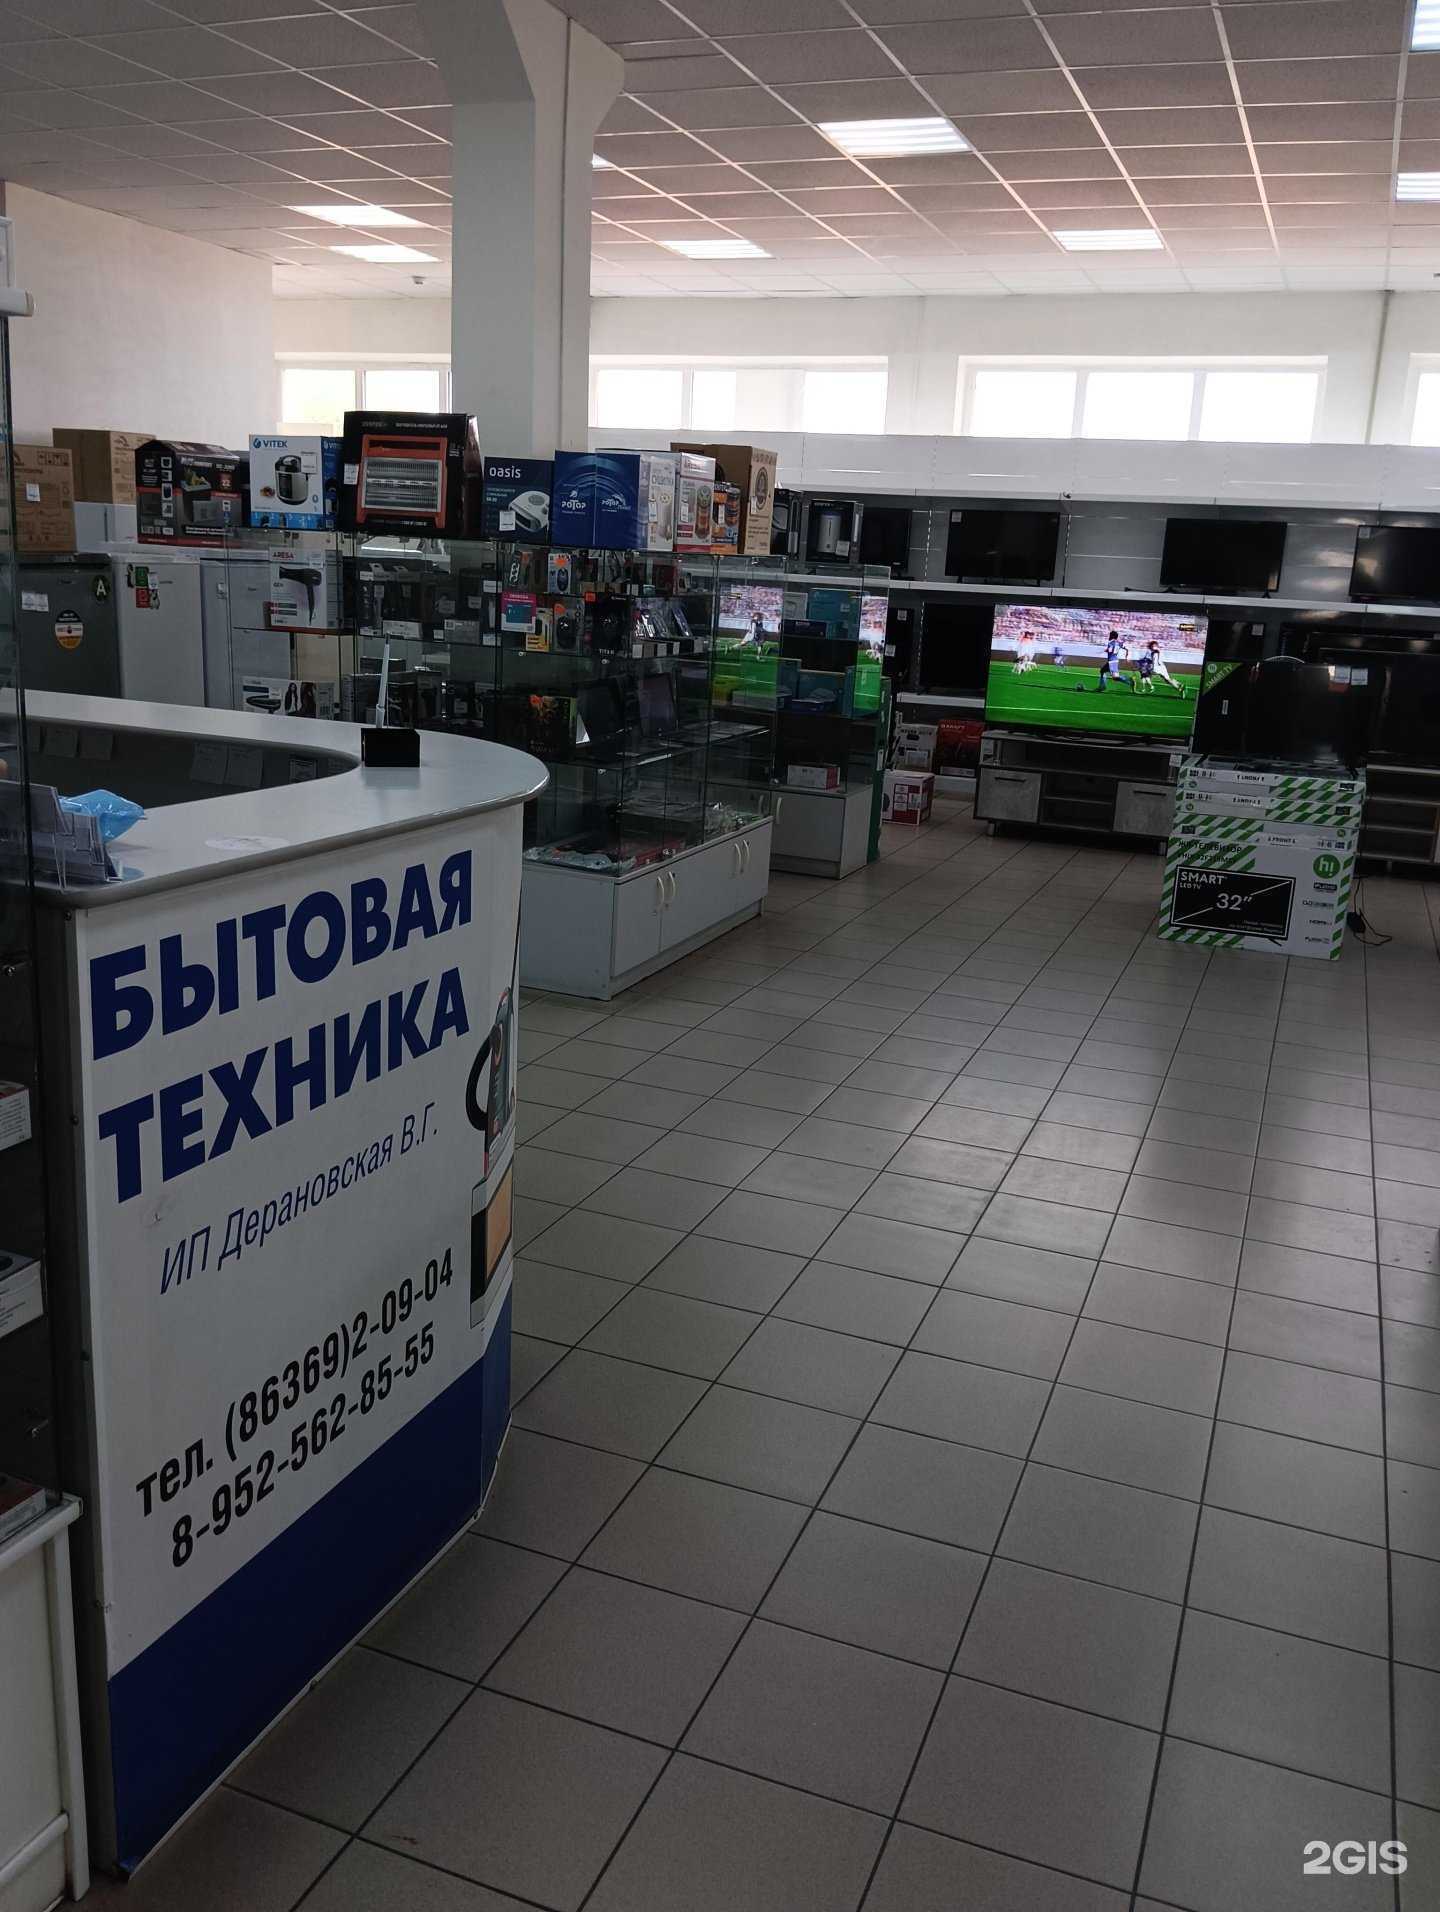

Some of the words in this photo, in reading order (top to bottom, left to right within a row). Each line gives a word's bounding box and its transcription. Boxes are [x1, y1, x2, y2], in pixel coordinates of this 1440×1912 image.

[263, 440, 288, 449] VITEK
[489, 466, 522, 479] oasis
[96, 579, 107, 596] A
[89, 850, 473, 1060] БЫТОВАЯ
[1180, 871, 1225, 886] SMART
[99, 967, 470, 1204] ТЕХНИКА
[160, 1226, 211, 1295] ИП
[217, 1133, 394, 1271] Дерановская
[400, 1102, 439, 1152] В.Г.
[136, 1438, 214, 1517] тел.
[225, 1247, 454, 1461] (86369)2-09-04
[172, 1321, 434, 1568] 8-952-562-85-55
